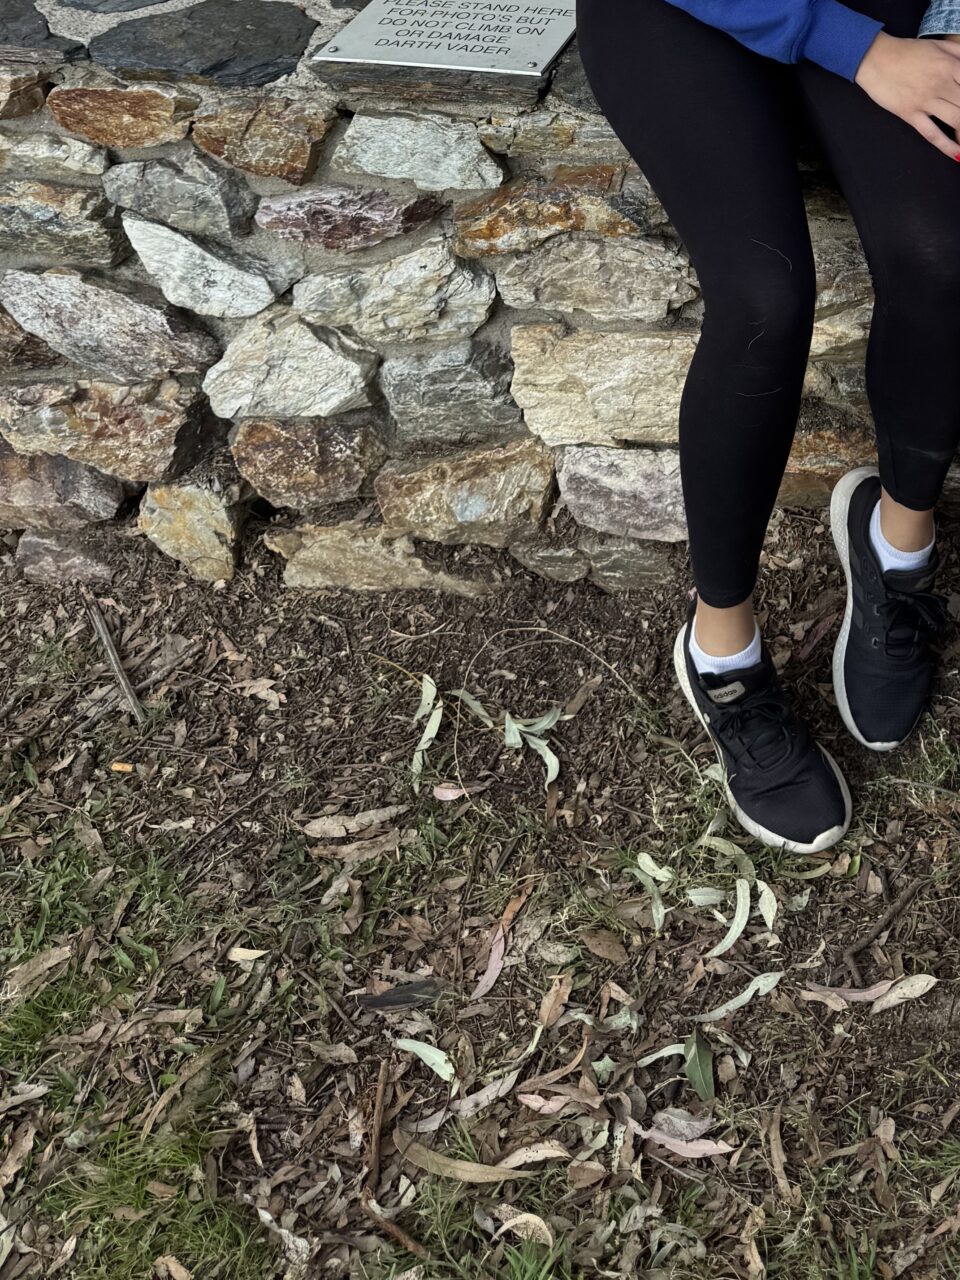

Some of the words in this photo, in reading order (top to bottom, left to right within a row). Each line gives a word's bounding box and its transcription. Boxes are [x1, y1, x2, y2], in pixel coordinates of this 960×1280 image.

[387, 7, 429, 17] FOR
[430, 10, 512, 23] PHOTO'S
[516, 16, 556, 26] BUT
[458, 2, 521, 13] STAND
[523, 6, 576, 17] HERE
[378, 17, 408, 27] DO
[411, 19, 453, 29] NOT
[455, 23, 512, 33] CLIMB
[516, 26, 546, 36] ON
[395, 28, 424, 38] OR
[427, 30, 511, 44] DAMAGE
[374, 38, 445, 50] DARTH
[447, 43, 511, 55] VADER
[714, 689, 737, 699] adidas
